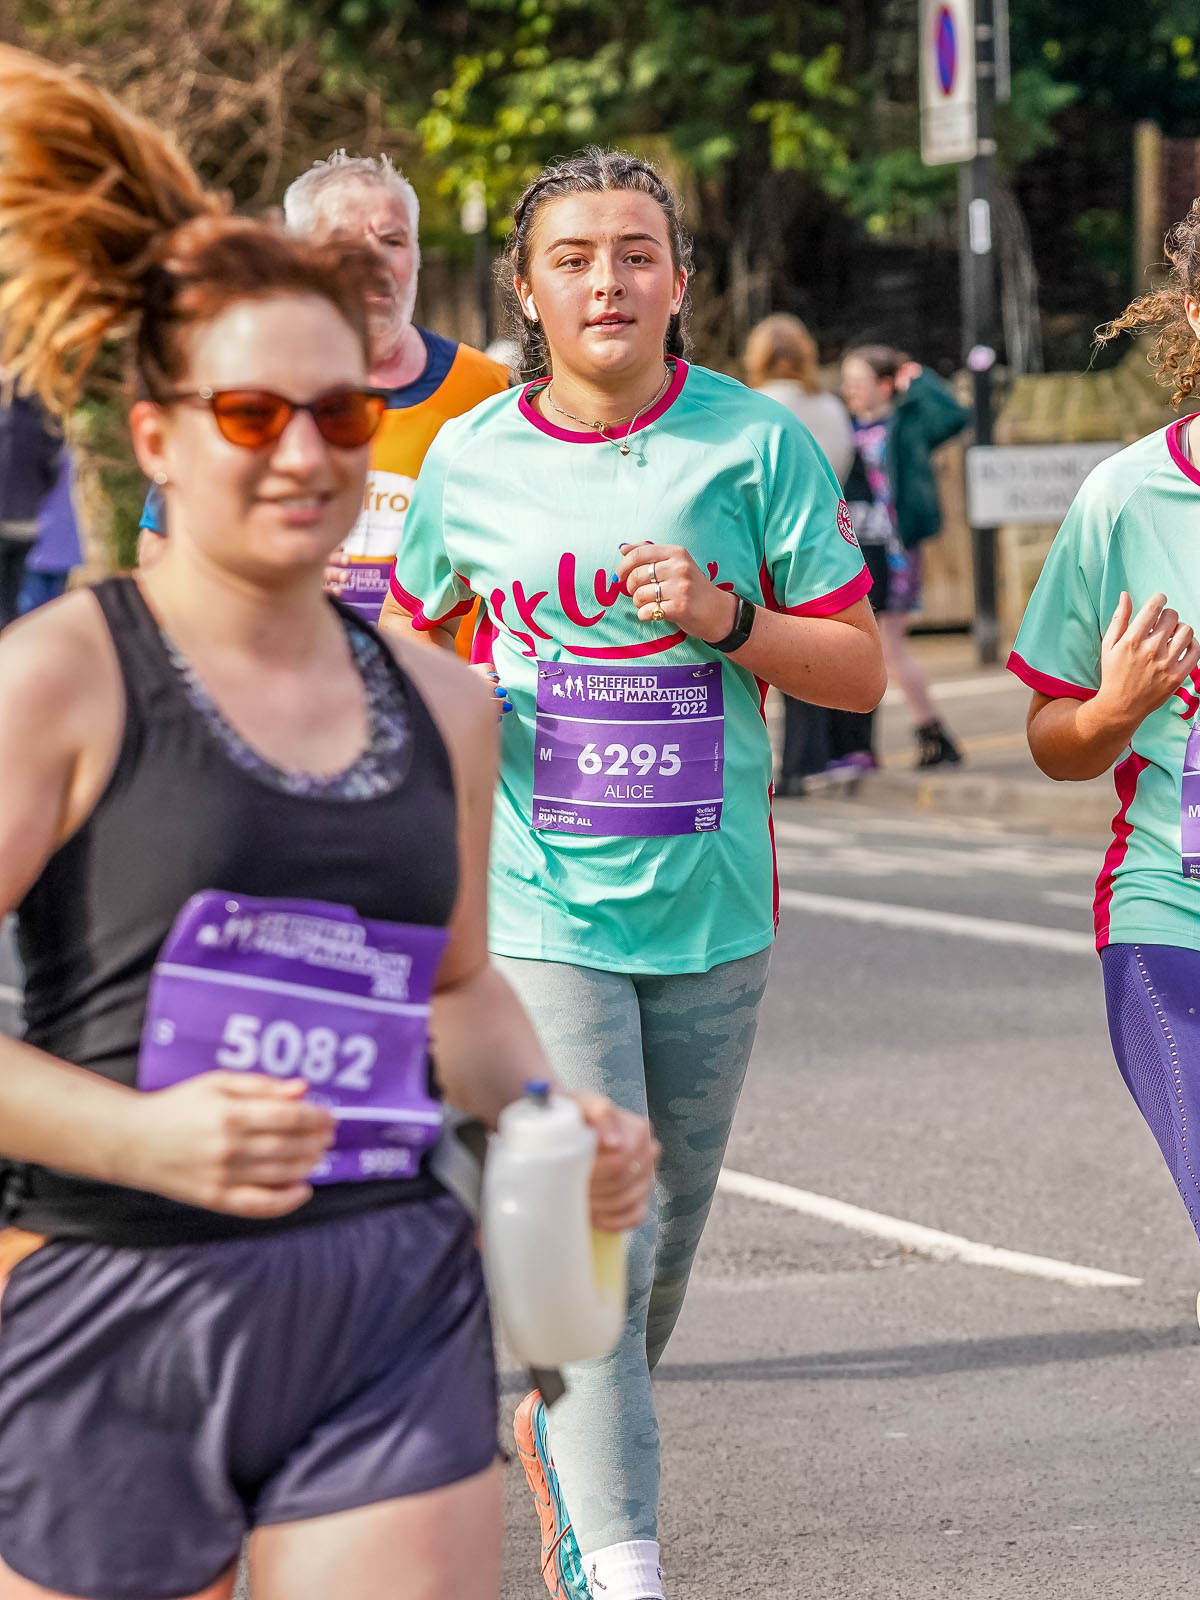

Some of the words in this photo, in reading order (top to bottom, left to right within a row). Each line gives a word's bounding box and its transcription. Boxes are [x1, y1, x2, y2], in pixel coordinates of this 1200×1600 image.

[588, 676, 655, 688] SHEFFIELD
[588, 689, 624, 701] HALF
[626, 688, 706, 701] MARATHON
[671, 702, 707, 716] 2022
[539, 747, 552, 761] M
[577, 743, 682, 776] 6295
[604, 785, 654, 799] ALICE
[1188, 804, 1200, 818] M
[538, 813, 557, 823] RUN
[558, 815, 575, 825] FOR
[577, 817, 593, 827] ALL
[216, 1012, 379, 1088] 5082
